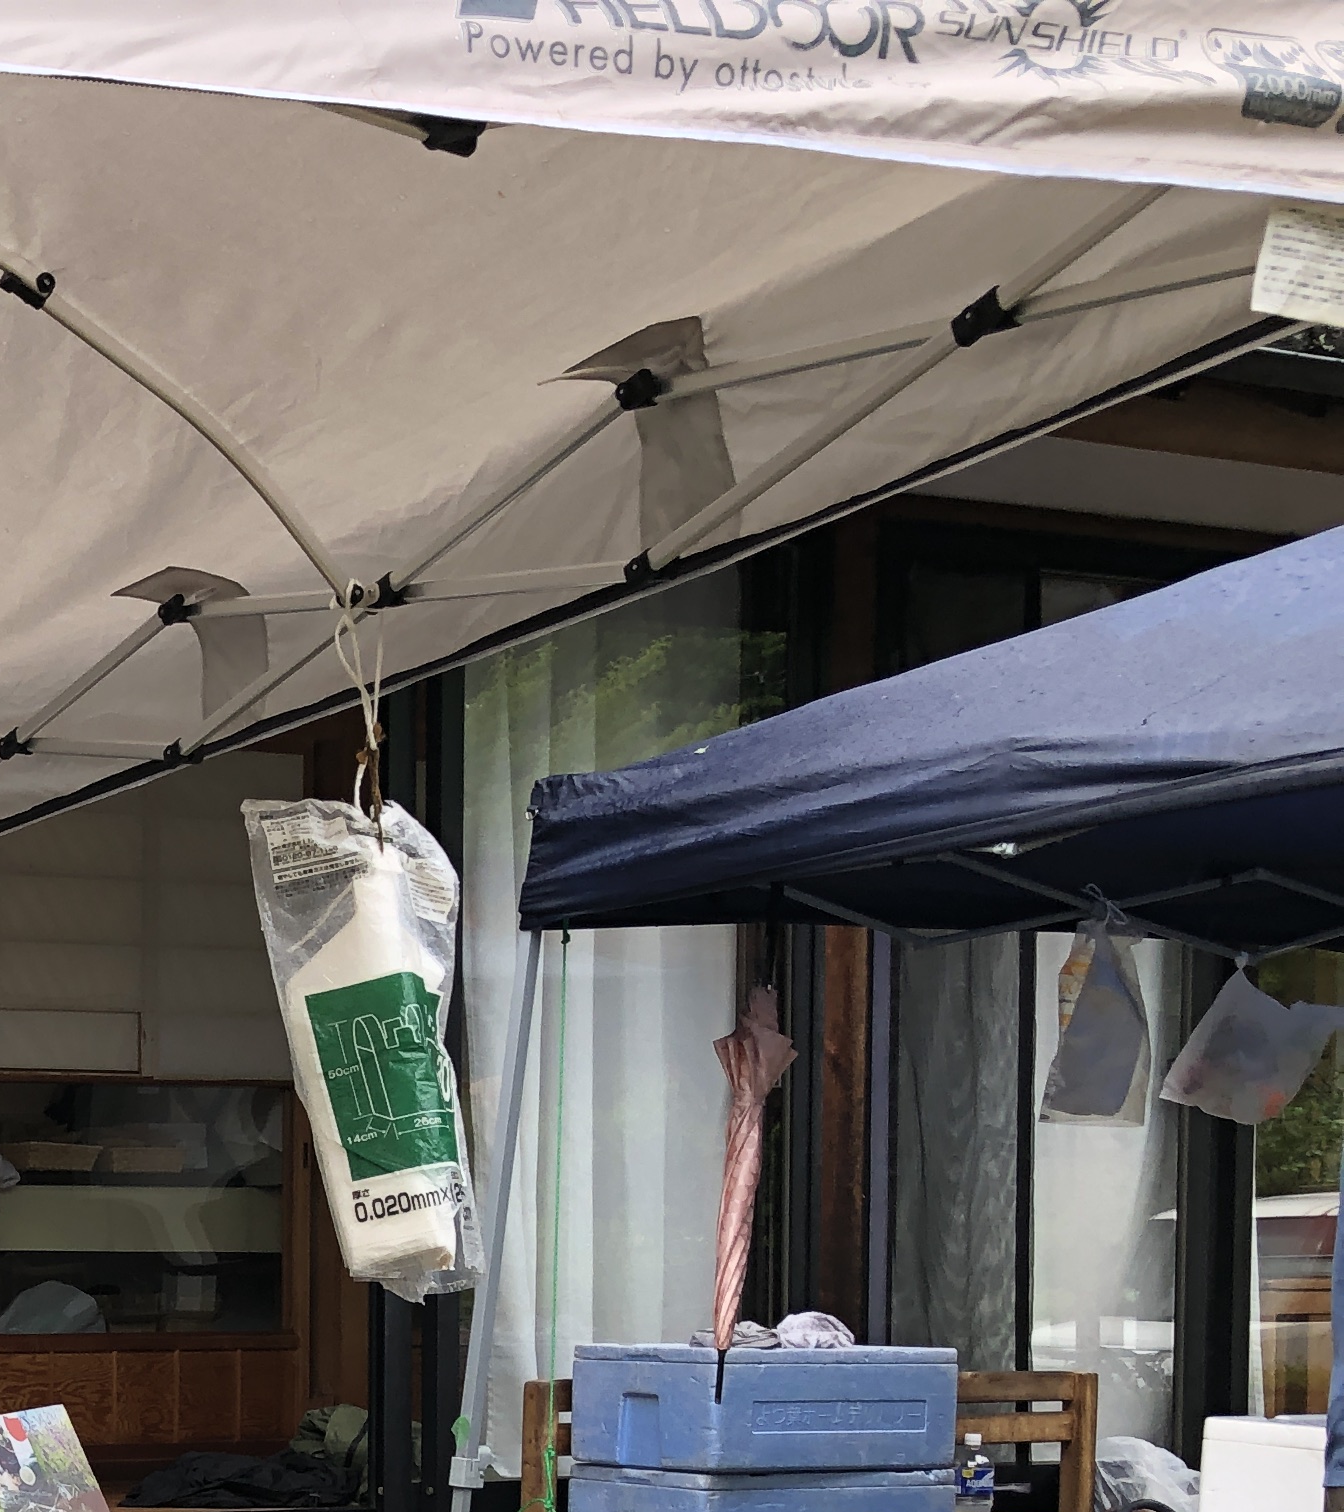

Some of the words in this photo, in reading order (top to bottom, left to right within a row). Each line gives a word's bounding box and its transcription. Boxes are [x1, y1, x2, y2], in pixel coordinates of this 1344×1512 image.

[458, 21, 634, 75] Powered
[654, 38, 699, 94] by
[328, 1063, 360, 1079] 50cm
[414, 1116, 443, 1128] 26cm
[347, 1131, 378, 1145] 14cm
